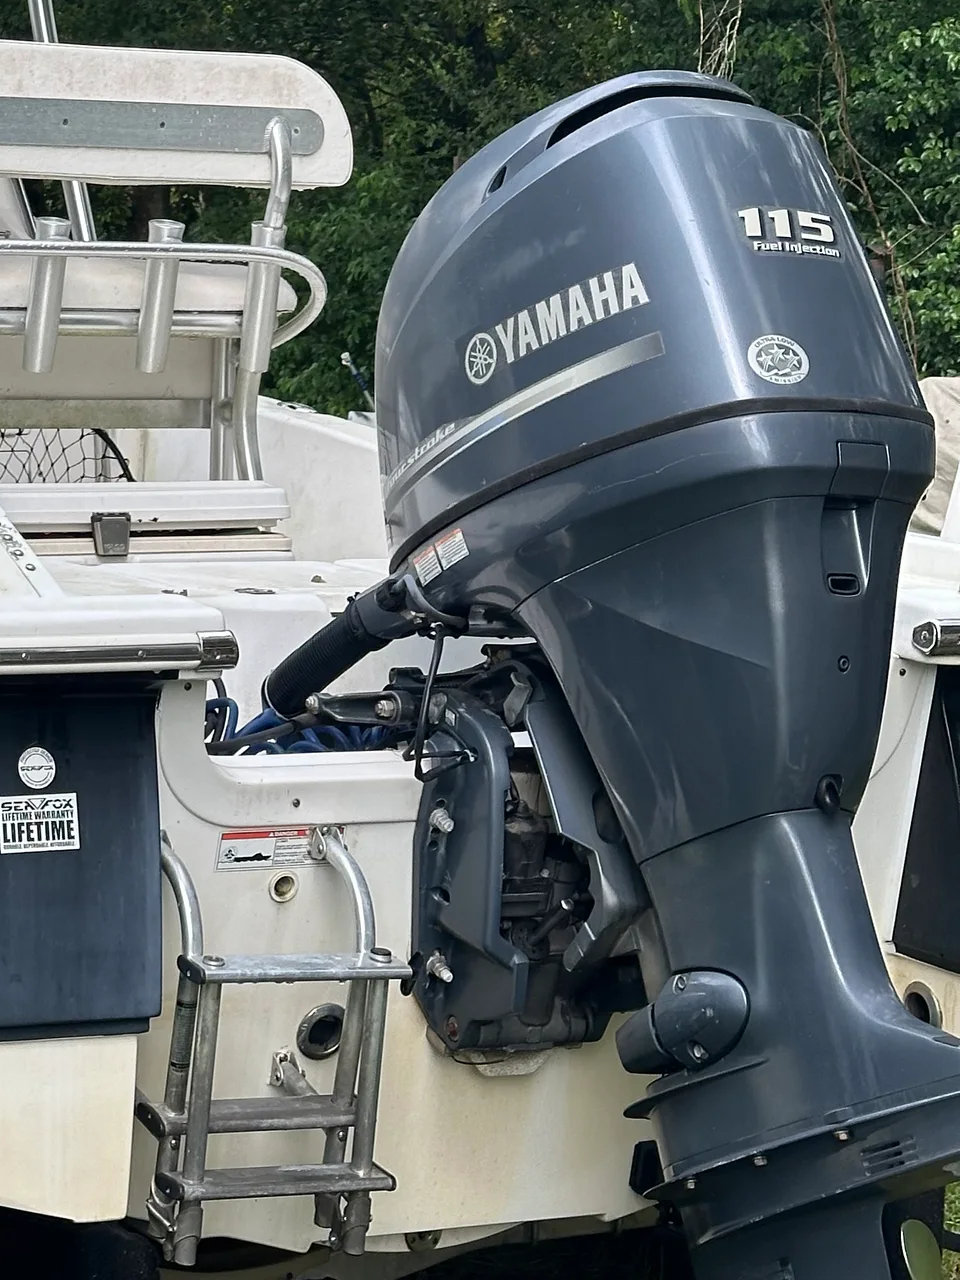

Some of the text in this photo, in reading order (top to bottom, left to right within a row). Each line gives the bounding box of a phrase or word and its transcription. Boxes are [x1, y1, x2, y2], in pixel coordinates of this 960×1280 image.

[737, 207, 835, 243] 115
[753, 241, 840, 258] Fuel Injection
[495, 262, 651, 365] YAMAHA
[1, 809, 74, 822] LIFETIME WARRANTY
[2, 820, 75, 843] LIFETIME
